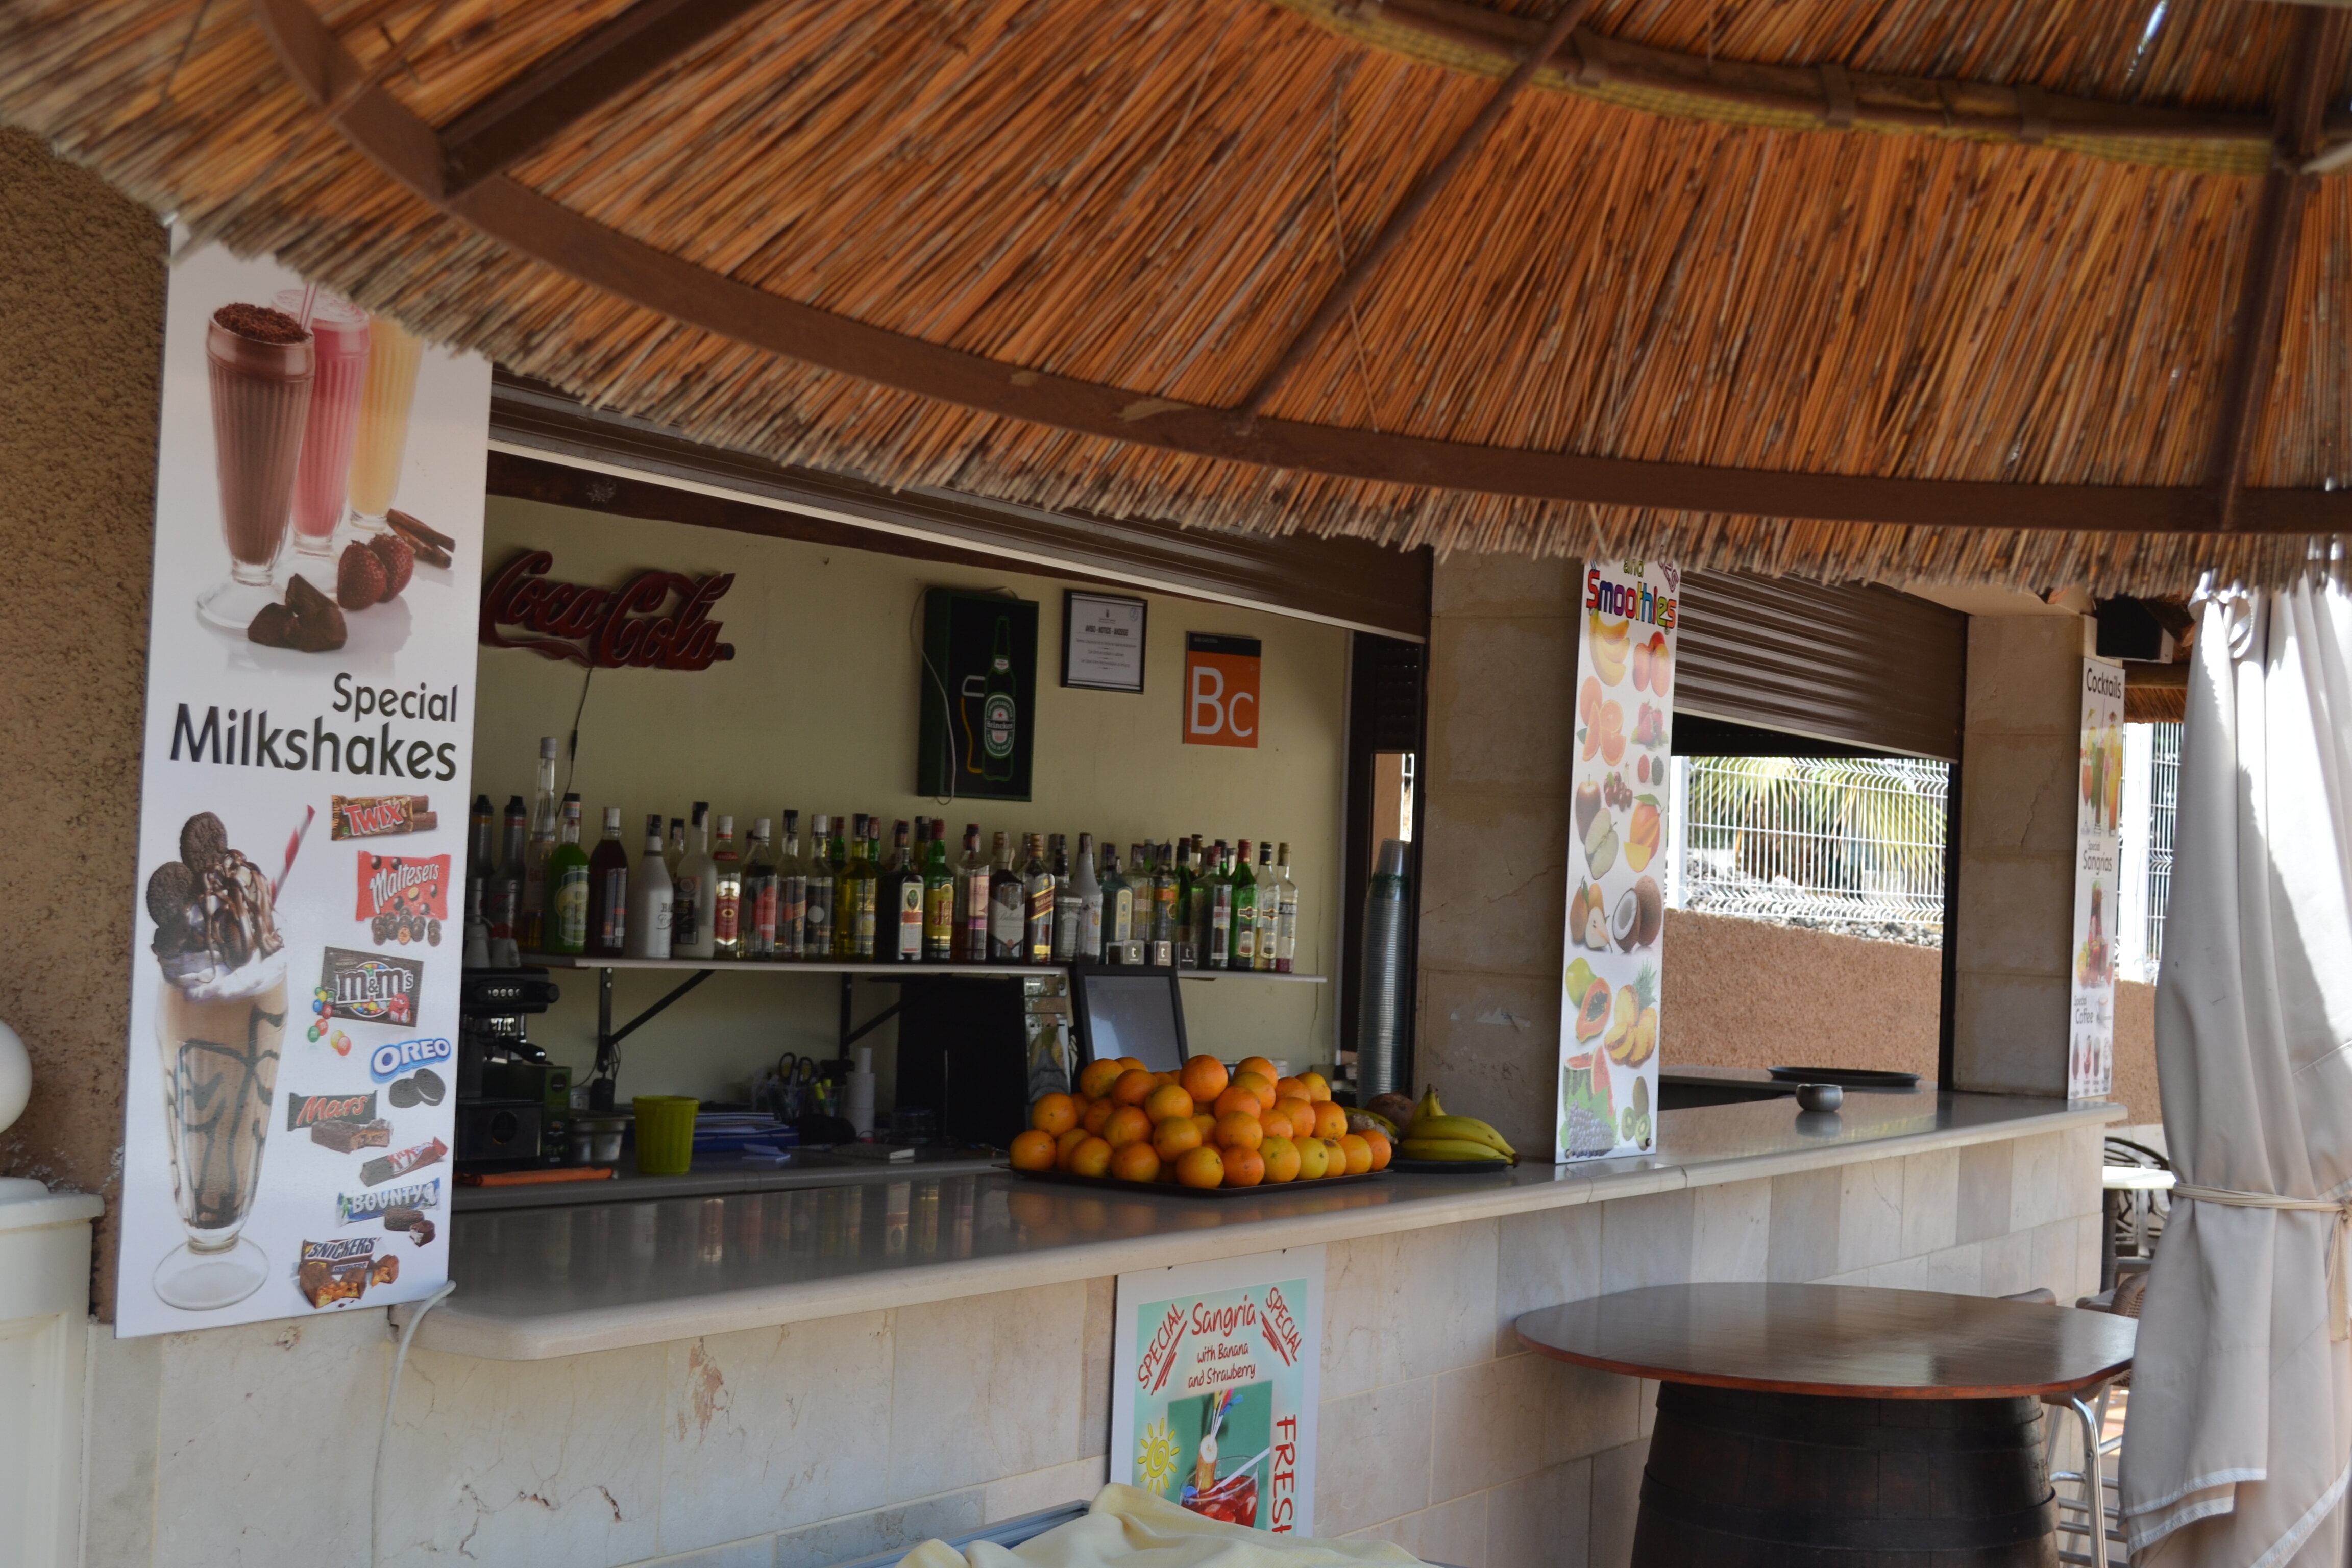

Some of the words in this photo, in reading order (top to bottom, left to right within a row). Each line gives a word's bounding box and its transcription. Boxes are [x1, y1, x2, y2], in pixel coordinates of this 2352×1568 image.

[1586, 569, 1677, 629] Smoothies
[333, 672, 458, 723] Special
[2087, 667, 2121, 699] Cocktails
[170, 703, 457, 782] Milkshakes
[2083, 850, 2112, 875] Sangrías
[369, 864, 439, 915] Maltesers
[2075, 1007, 2094, 1024] Coffee
[373, 1039, 450, 1074] OREO
[296, 1096, 368, 1126] Mars
[352, 1184, 423, 1213] BOUNTY
[307, 1238, 376, 1259] SNICKERS
[1191, 1295, 1257, 1337] Sangria
[1266, 1287, 1303, 1362] SPECIAL
[1138, 1303, 1185, 1390] SPECIAL
[1197, 1347, 1216, 1365] with
[1218, 1343, 1249, 1360] Banana
[1188, 1368, 1205, 1389] and
[1207, 1363, 1256, 1386] Strawberry
